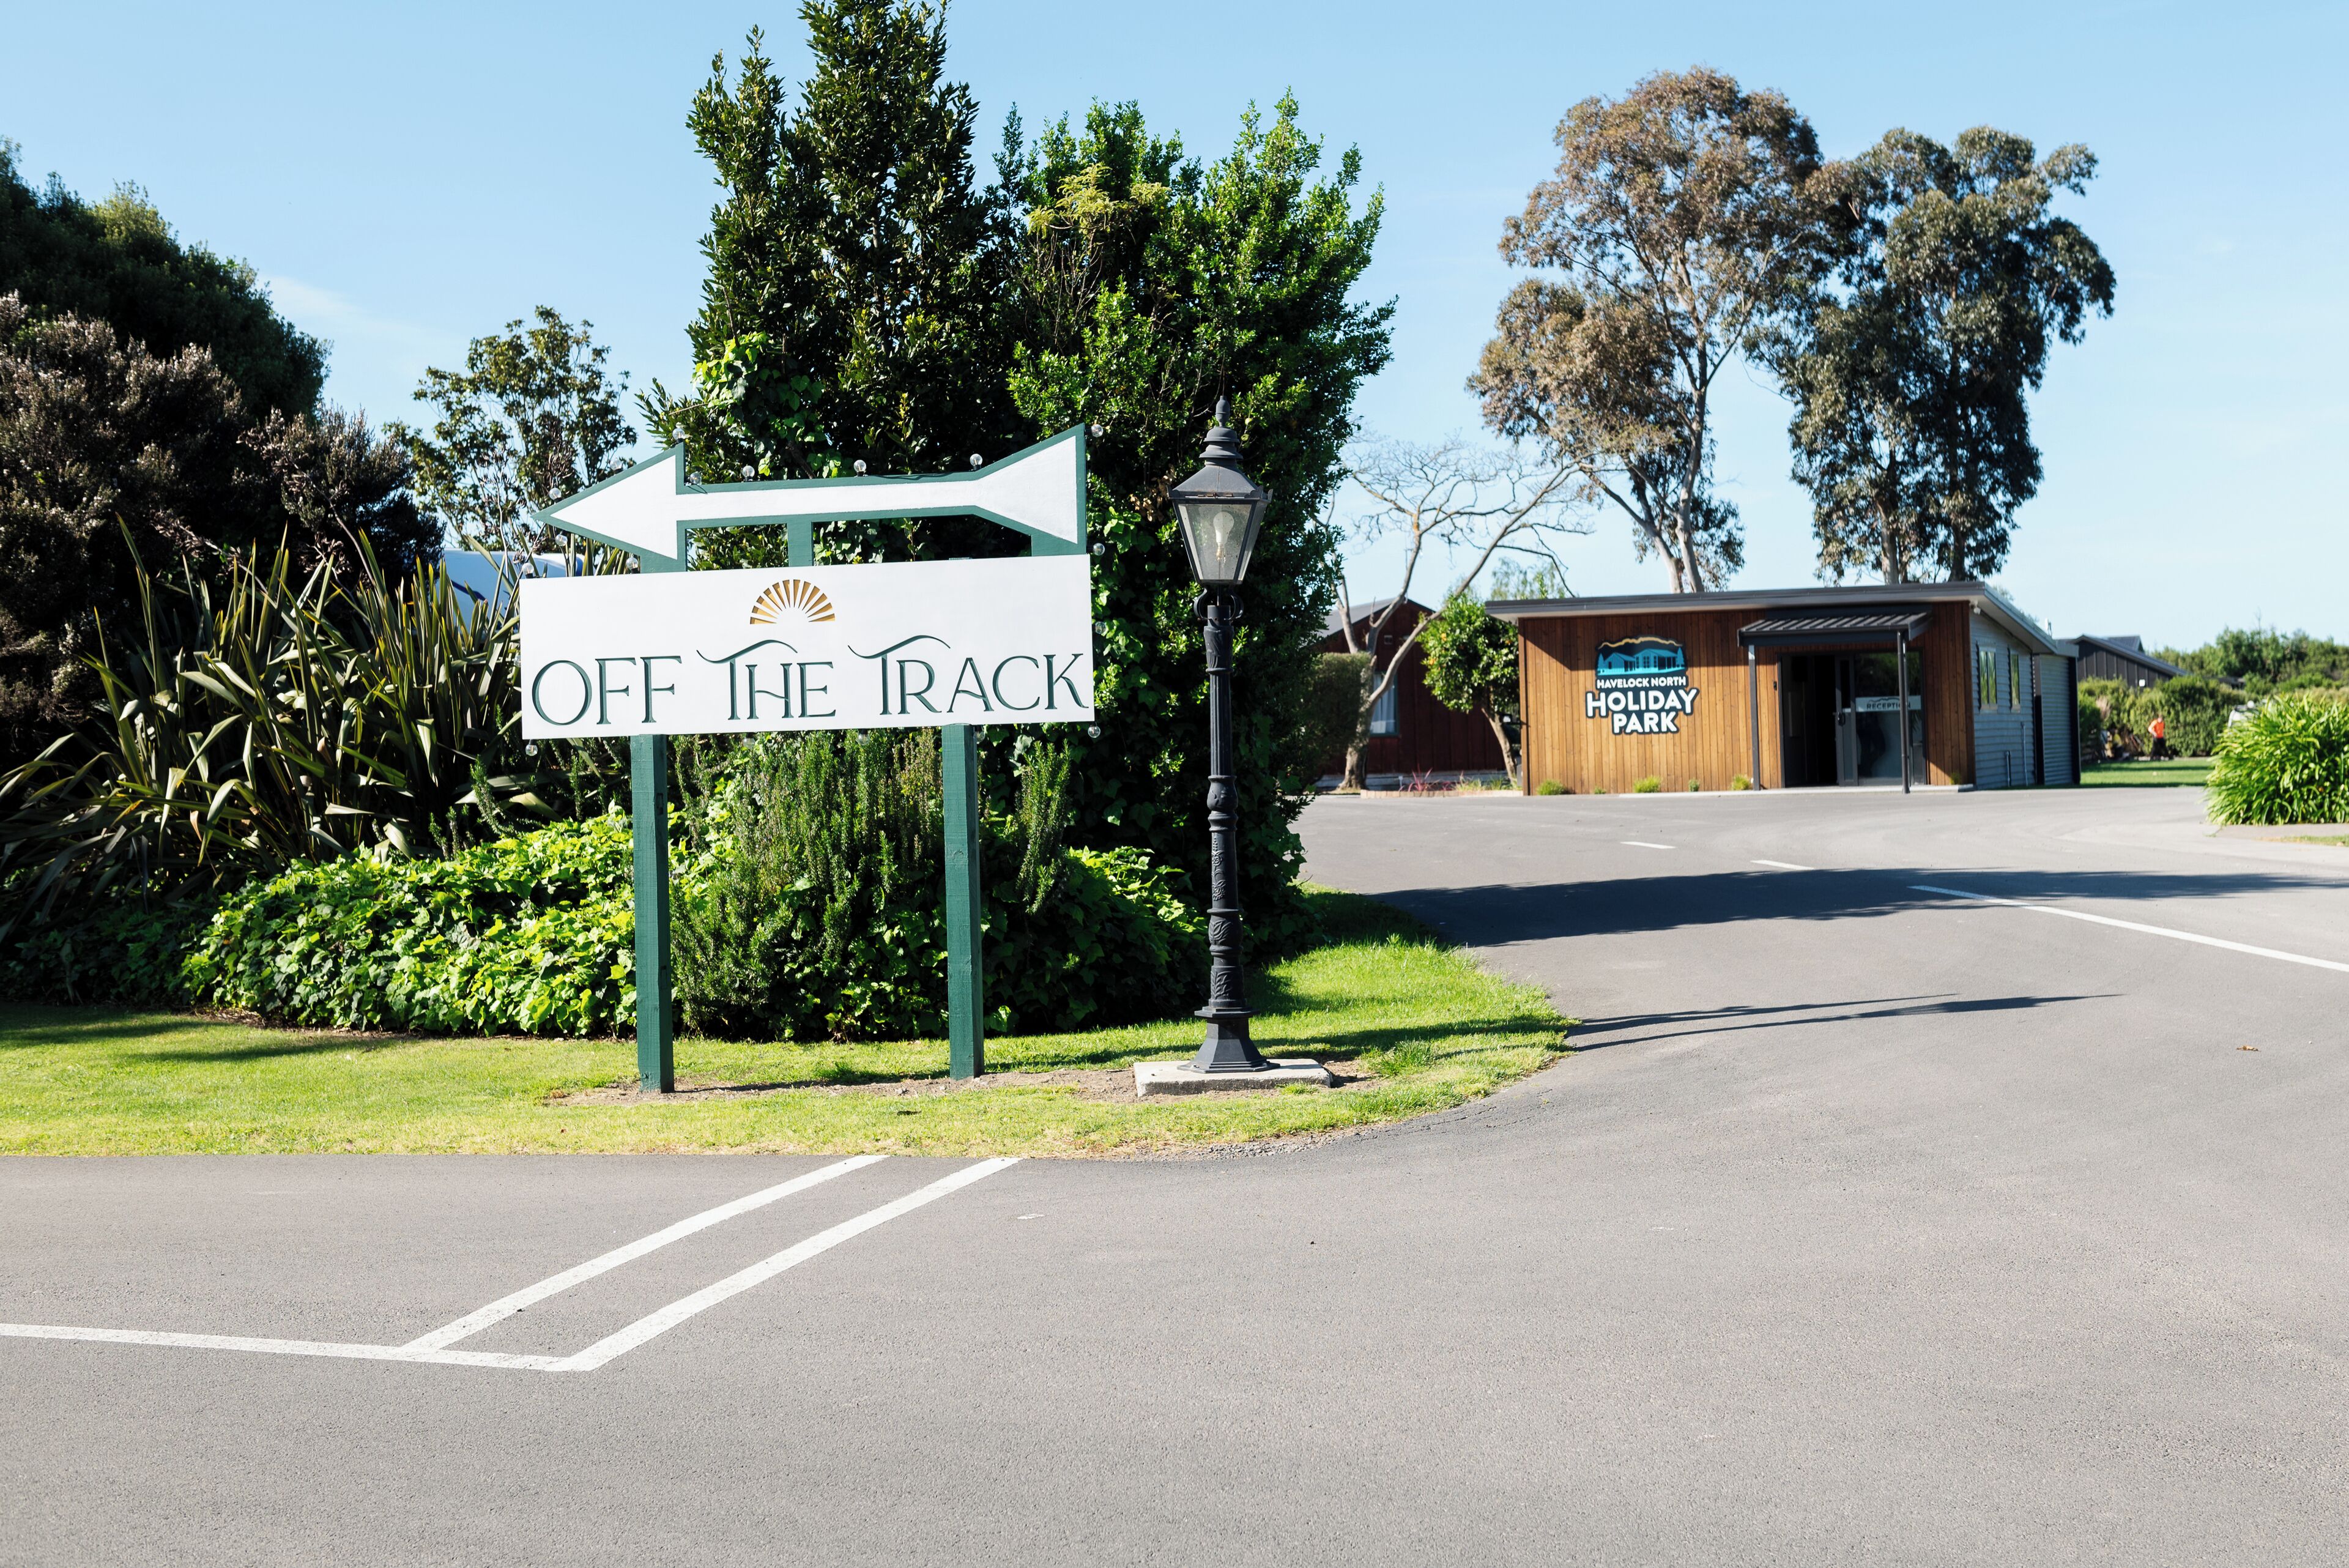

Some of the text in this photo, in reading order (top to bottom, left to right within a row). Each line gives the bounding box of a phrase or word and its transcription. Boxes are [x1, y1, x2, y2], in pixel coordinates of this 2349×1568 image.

[531, 634, 1089, 726] OFF THE TRACK
[1597, 676, 1686, 689] HAVELOCK NORTH
[1586, 689, 1697, 716] HOLIDAY
[1613, 712, 1677, 734] PARK
